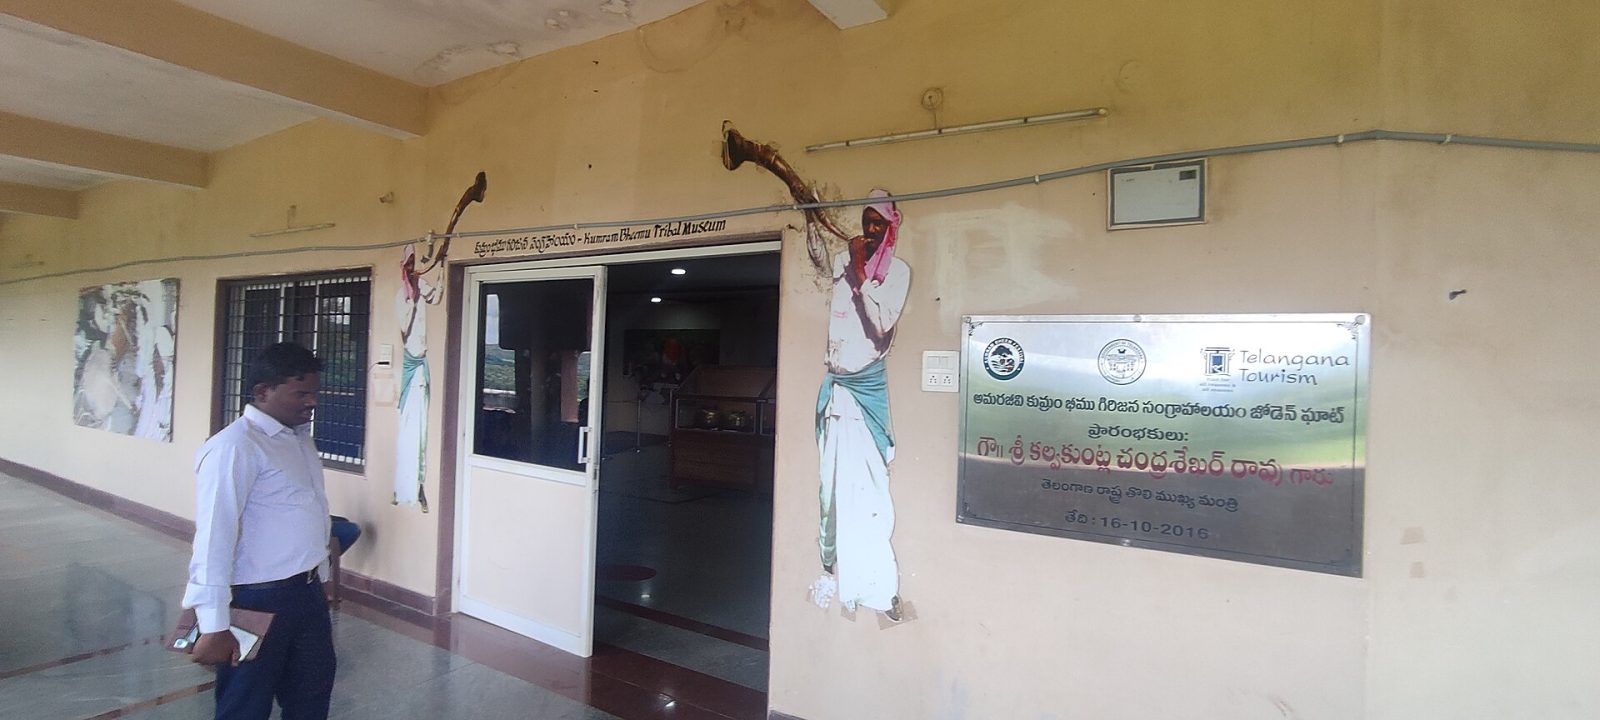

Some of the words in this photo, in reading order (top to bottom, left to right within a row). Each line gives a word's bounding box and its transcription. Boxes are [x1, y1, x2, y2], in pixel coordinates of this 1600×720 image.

[584, 231, 619, 244] Kumram
[653, 221, 681, 238] Tribal
[682, 219, 727, 236] Museum
[1239, 348, 1350, 371] Telangana
[1239, 368, 1318, 385] Tourism
[1027, 395, 1062, 411] కుమ్రం
[1098, 397, 1139, 413] గిరిజన
[1143, 400, 1247, 418] సంగ్రాహాలయం
[1301, 406, 1345, 425] ఘాట్
[1088, 423, 1189, 442] ప్రారంభకులు:
[1009, 434, 1025, 465] శ్రీ
[1029, 441, 1112, 474] కల్వకుంట్ల
[1116, 446, 1225, 480] చంద్రశేఖర్
[1231, 459, 1283, 487] రావు
[1290, 468, 1334, 485] గారు
[1041, 478, 1093, 494] తెలంగాణ
[1155, 490, 1196, 509] ముఖ్య
[1199, 495, 1239, 512] మంత్రి
[1100, 516, 1209, 540] 16-10-2016
